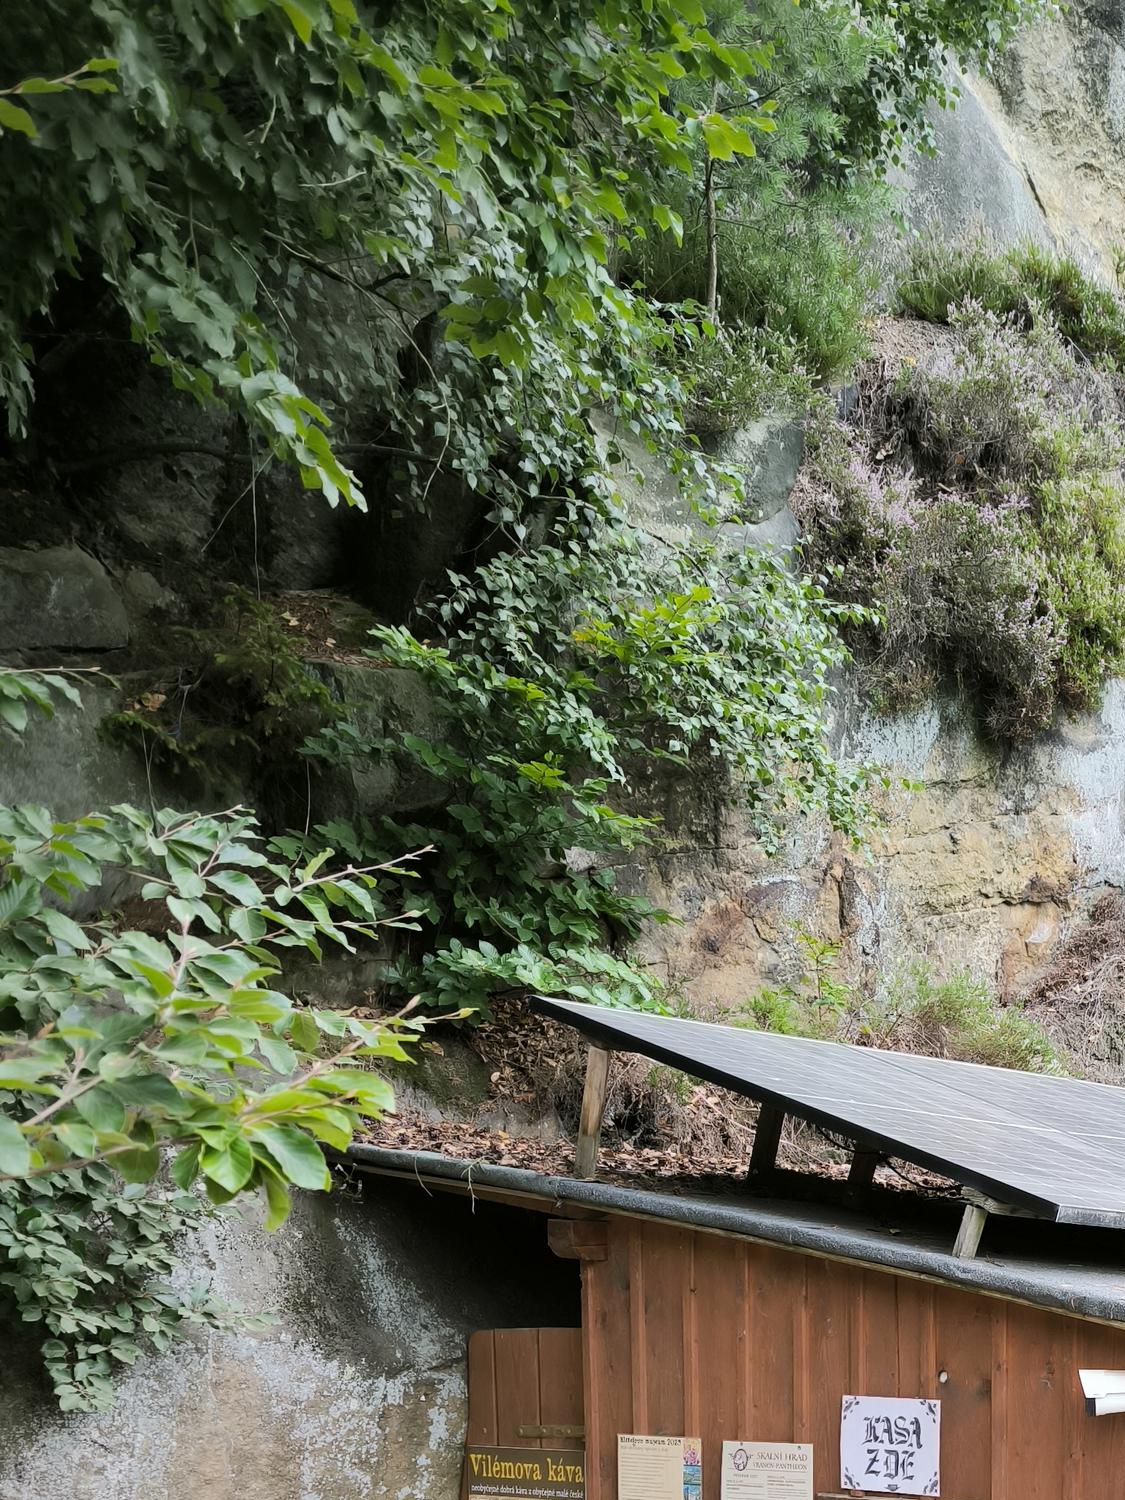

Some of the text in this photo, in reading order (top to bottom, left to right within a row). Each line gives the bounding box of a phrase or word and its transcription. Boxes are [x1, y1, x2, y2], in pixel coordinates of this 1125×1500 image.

[861, 1415, 923, 1449] KASA
[470, 1453, 584, 1483] Vilémova káva
[756, 1451, 808, 1463] SKALNÍ HRAD
[864, 1448, 916, 1481] ZDE
